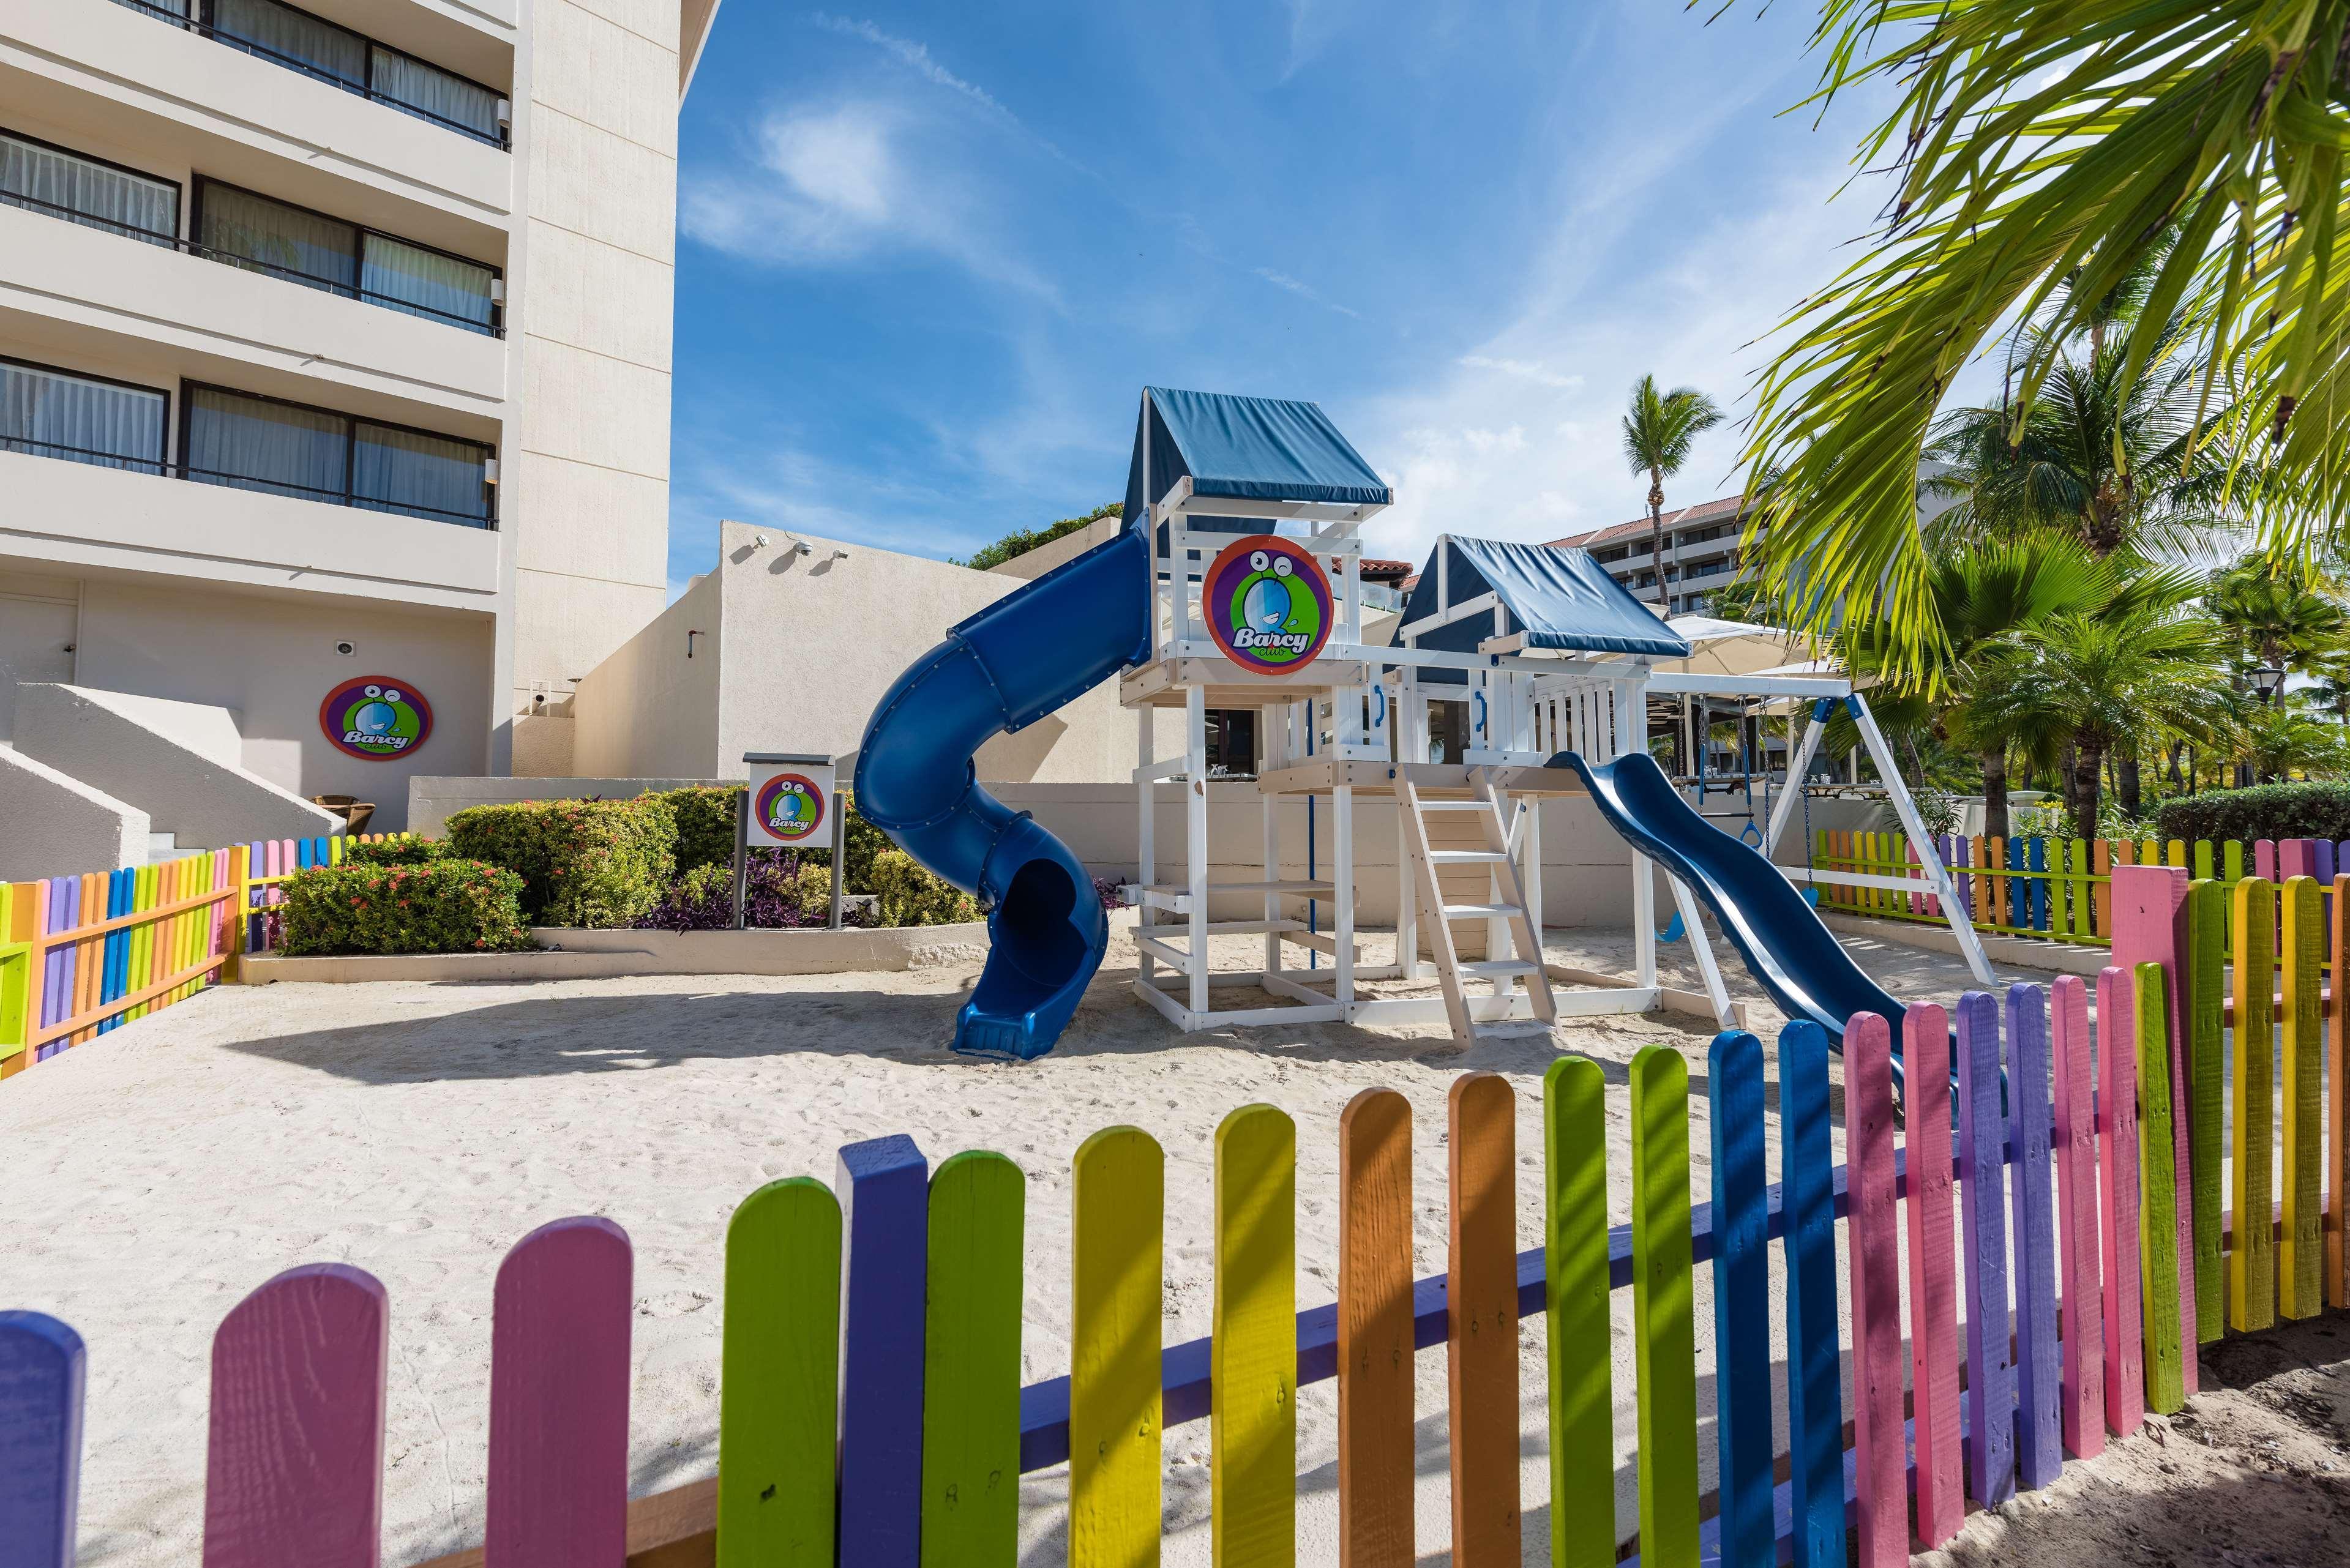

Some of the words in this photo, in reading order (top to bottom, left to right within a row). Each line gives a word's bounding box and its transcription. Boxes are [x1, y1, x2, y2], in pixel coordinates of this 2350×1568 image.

[1233, 628, 1308, 653] Barcy
[1259, 647, 1285, 656] club
[343, 731, 408, 749] Barcy
[769, 818, 809, 831] Barcy
